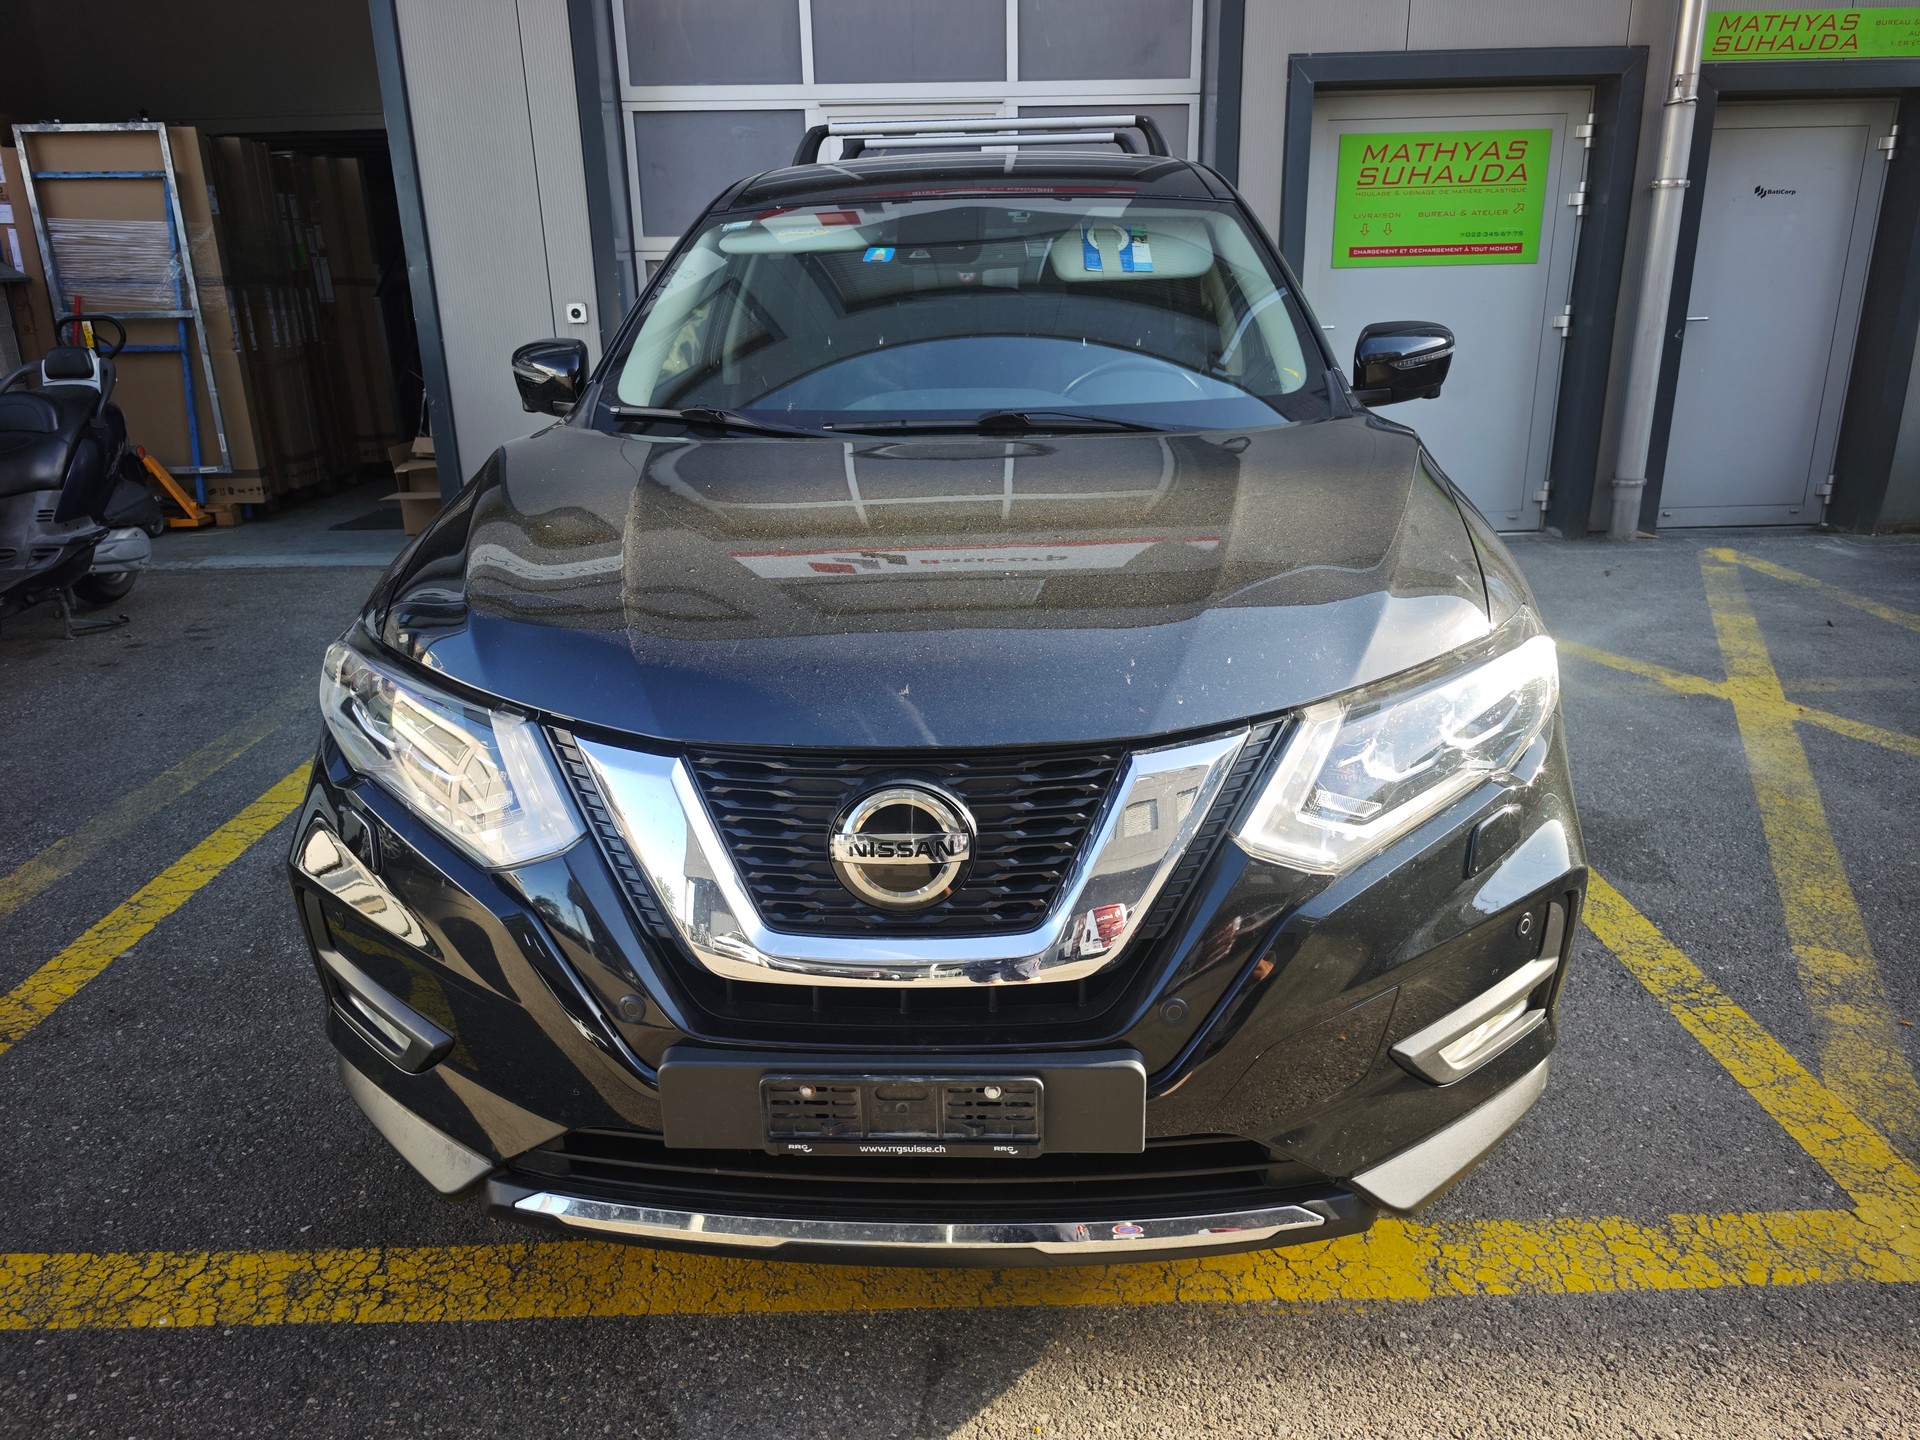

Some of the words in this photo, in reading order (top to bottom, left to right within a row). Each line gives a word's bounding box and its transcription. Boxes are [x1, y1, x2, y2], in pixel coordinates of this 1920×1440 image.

[1718, 13, 1861, 33] MATHYAS
[1712, 33, 1858, 52] SUHAJDA
[1361, 140, 1529, 164] MATHYAS
[1356, 163, 1528, 186] SUHAJDA
[1418, 210, 1456, 218] BUREAU
[1460, 209, 1467, 217] &
[848, 840, 955, 858] NISSAN
[788, 1144, 812, 1152] RRG
[859, 1144, 947, 1154] www.rrgsuisse.ch
[994, 1145, 1018, 1154] RRG
